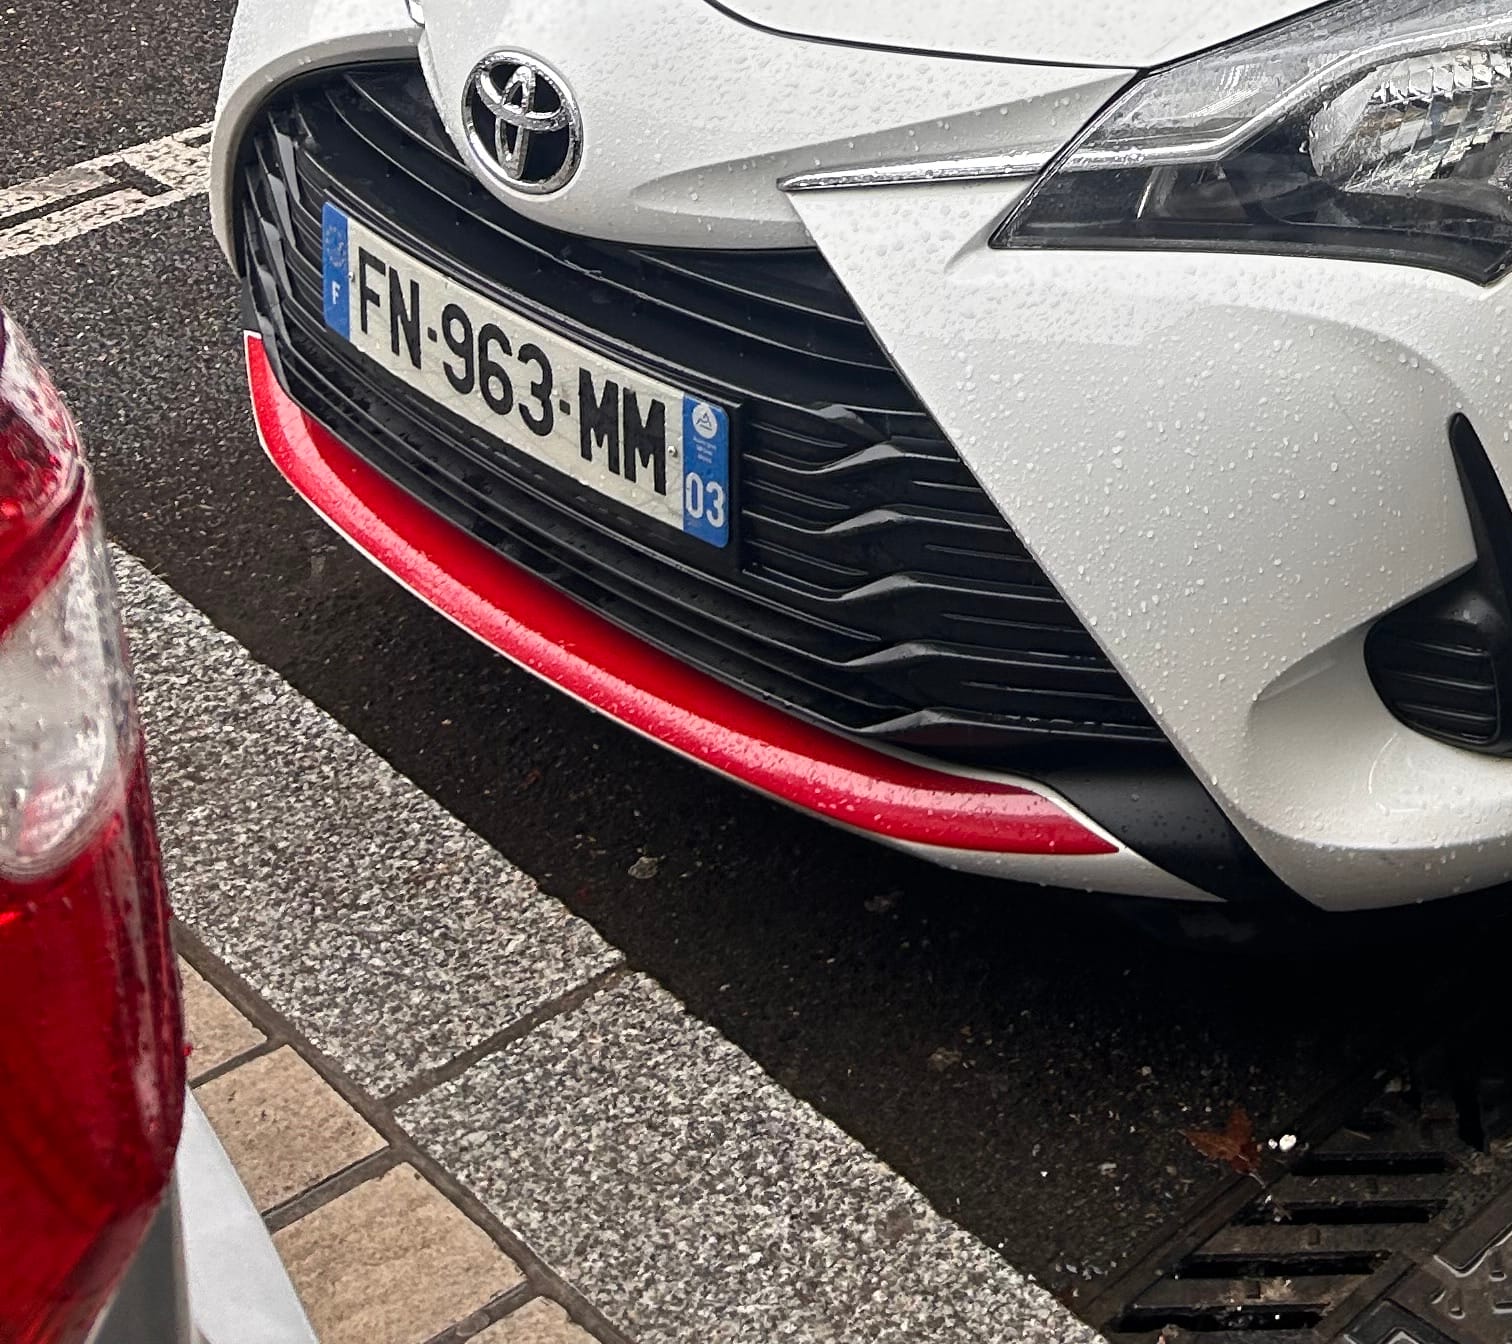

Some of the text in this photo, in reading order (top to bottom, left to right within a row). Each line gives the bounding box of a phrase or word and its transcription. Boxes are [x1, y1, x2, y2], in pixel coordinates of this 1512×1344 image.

[331, 279, 343, 306] F
[357, 245, 668, 497] FN-963-MM
[685, 471, 725, 528] 03
